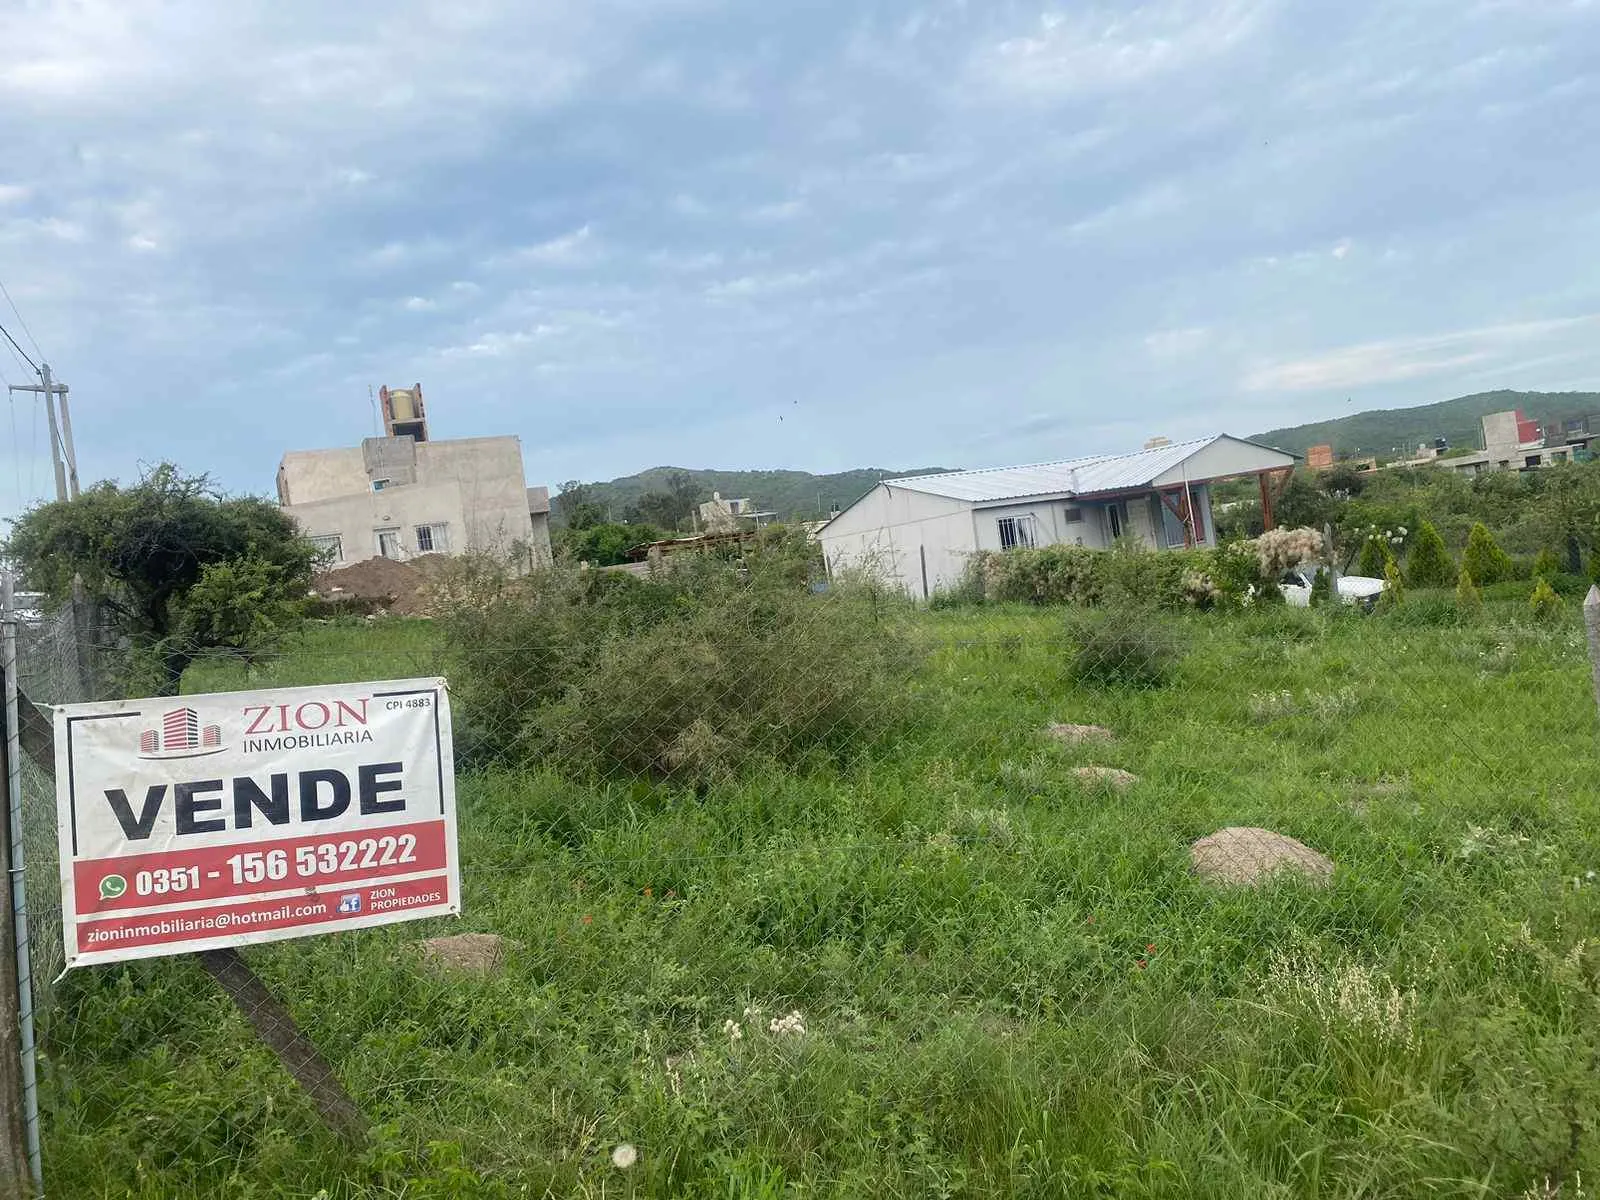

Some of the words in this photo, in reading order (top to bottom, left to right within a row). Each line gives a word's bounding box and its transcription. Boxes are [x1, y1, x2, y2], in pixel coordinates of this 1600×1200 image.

[243, 699, 370, 735] ZION
[386, 701, 403, 711] CPI
[405, 698, 431, 709] 4883
[243, 729, 374, 753] INMOBILIARIA
[104, 761, 406, 841] VENDE
[136, 865, 200, 896] 0351
[226, 850, 288, 885] 156
[296, 834, 417, 877] 532222
[370, 887, 396, 899] ZION
[370, 892, 441, 911] PROPIEDADES
[87, 902, 327, 943] zioninmobiliaria@hotmail.com
